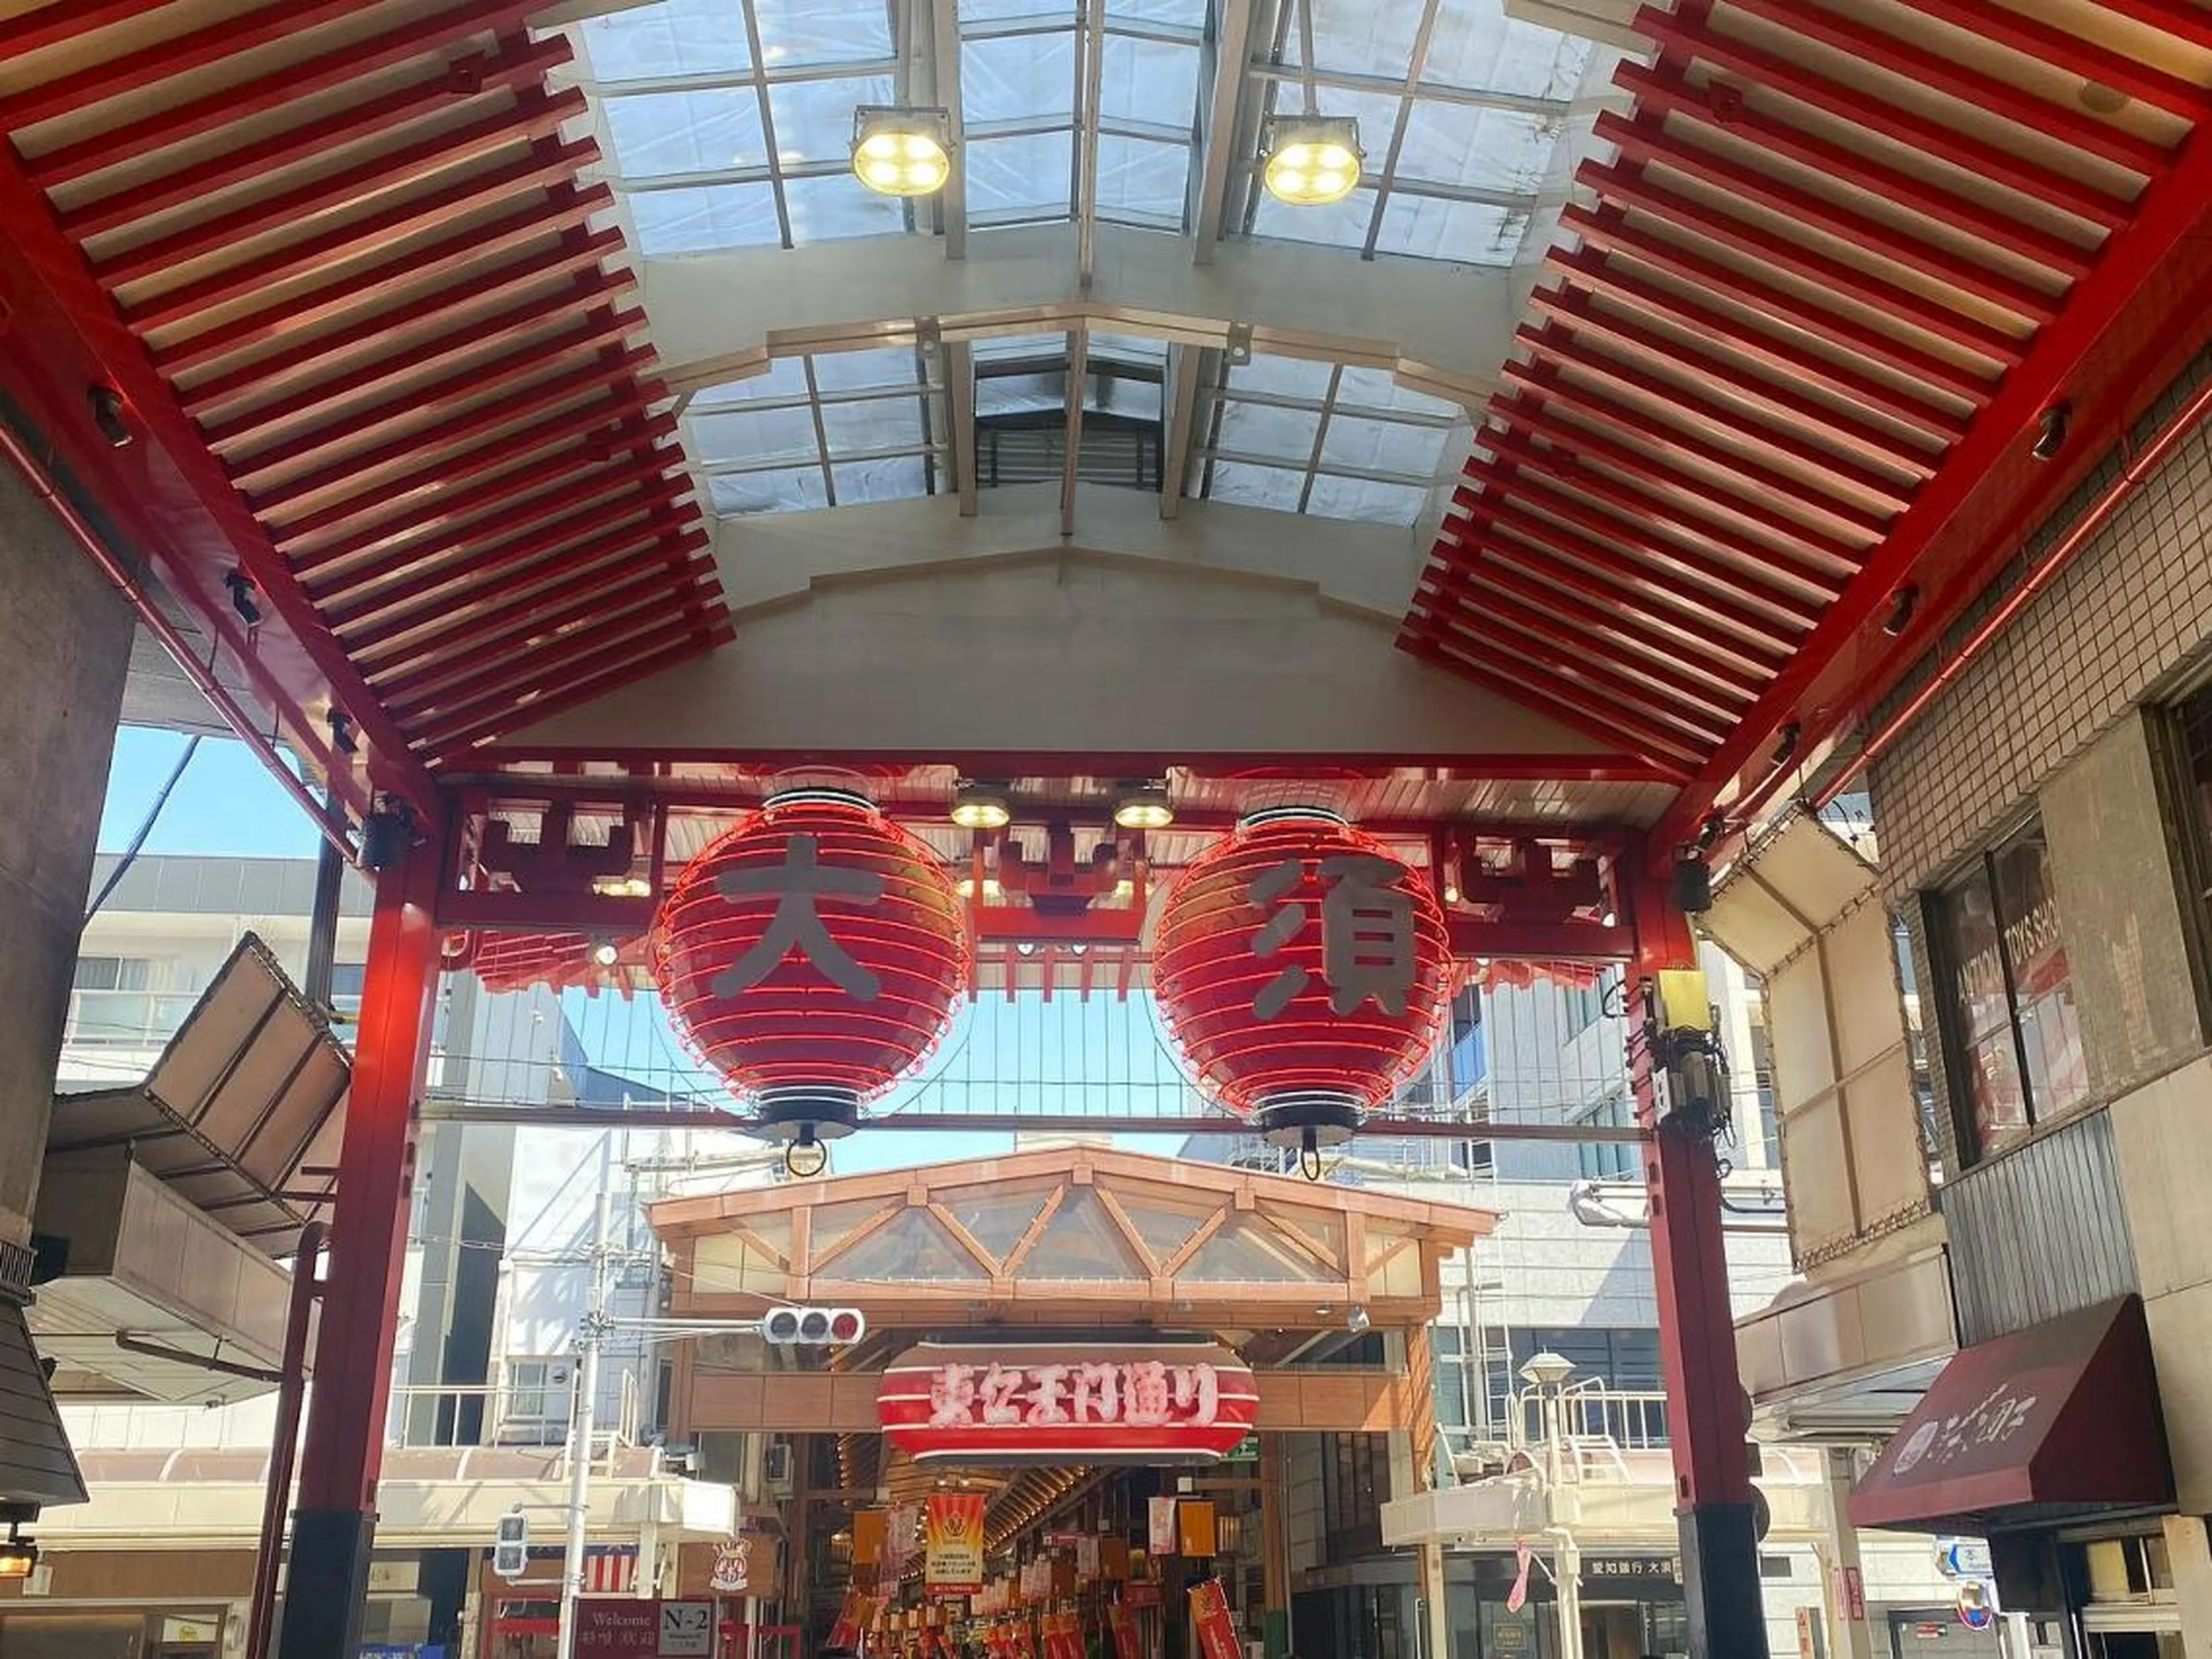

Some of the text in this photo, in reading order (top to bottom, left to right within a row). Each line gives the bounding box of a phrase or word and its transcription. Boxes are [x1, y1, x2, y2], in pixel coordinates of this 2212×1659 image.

[711, 833, 883, 1001] 大
[1247, 857, 1415, 1019] 須
[1957, 942, 2006, 1007] ANTIQU
[2003, 915, 2035, 968] TOYS
[593, 1611, 652, 1626] Welcome
[664, 1608, 708, 1630] N-2
